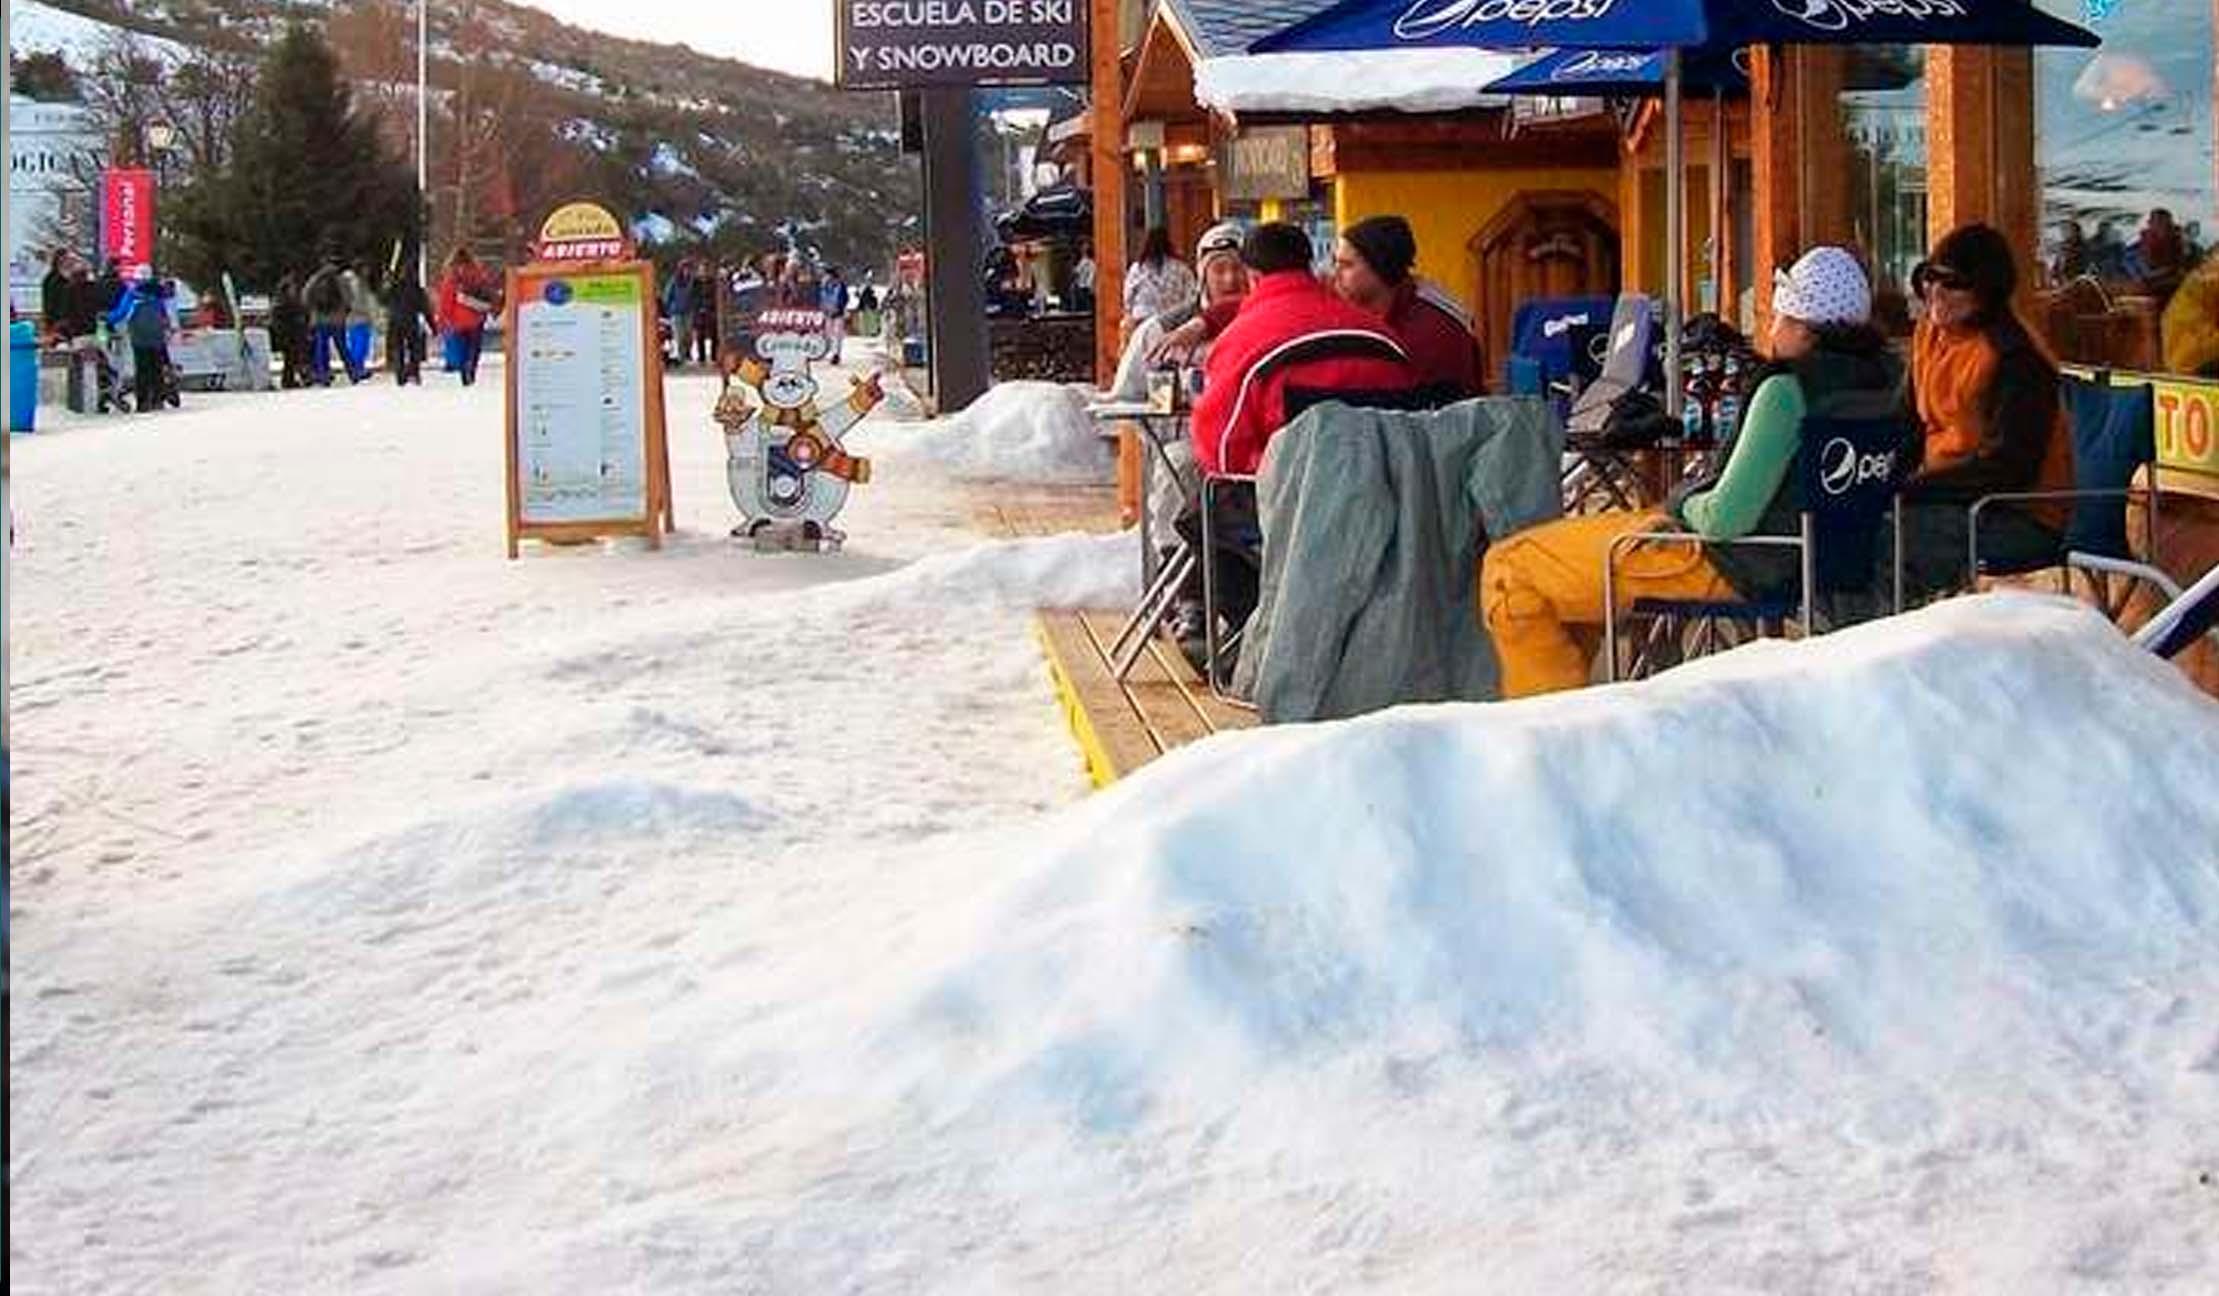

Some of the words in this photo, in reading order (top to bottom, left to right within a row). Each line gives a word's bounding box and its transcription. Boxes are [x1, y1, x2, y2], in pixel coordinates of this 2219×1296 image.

[852, 0, 977, 27] ESCUELA
[984, 0, 1024, 24] DE
[1030, 0, 1072, 24] SKI
[850, 46, 870, 71] Y
[877, 43, 1076, 71] SNOWBOARD
[542, 241, 622, 259] ABIERTO
[757, 309, 825, 326] ABIERTO
